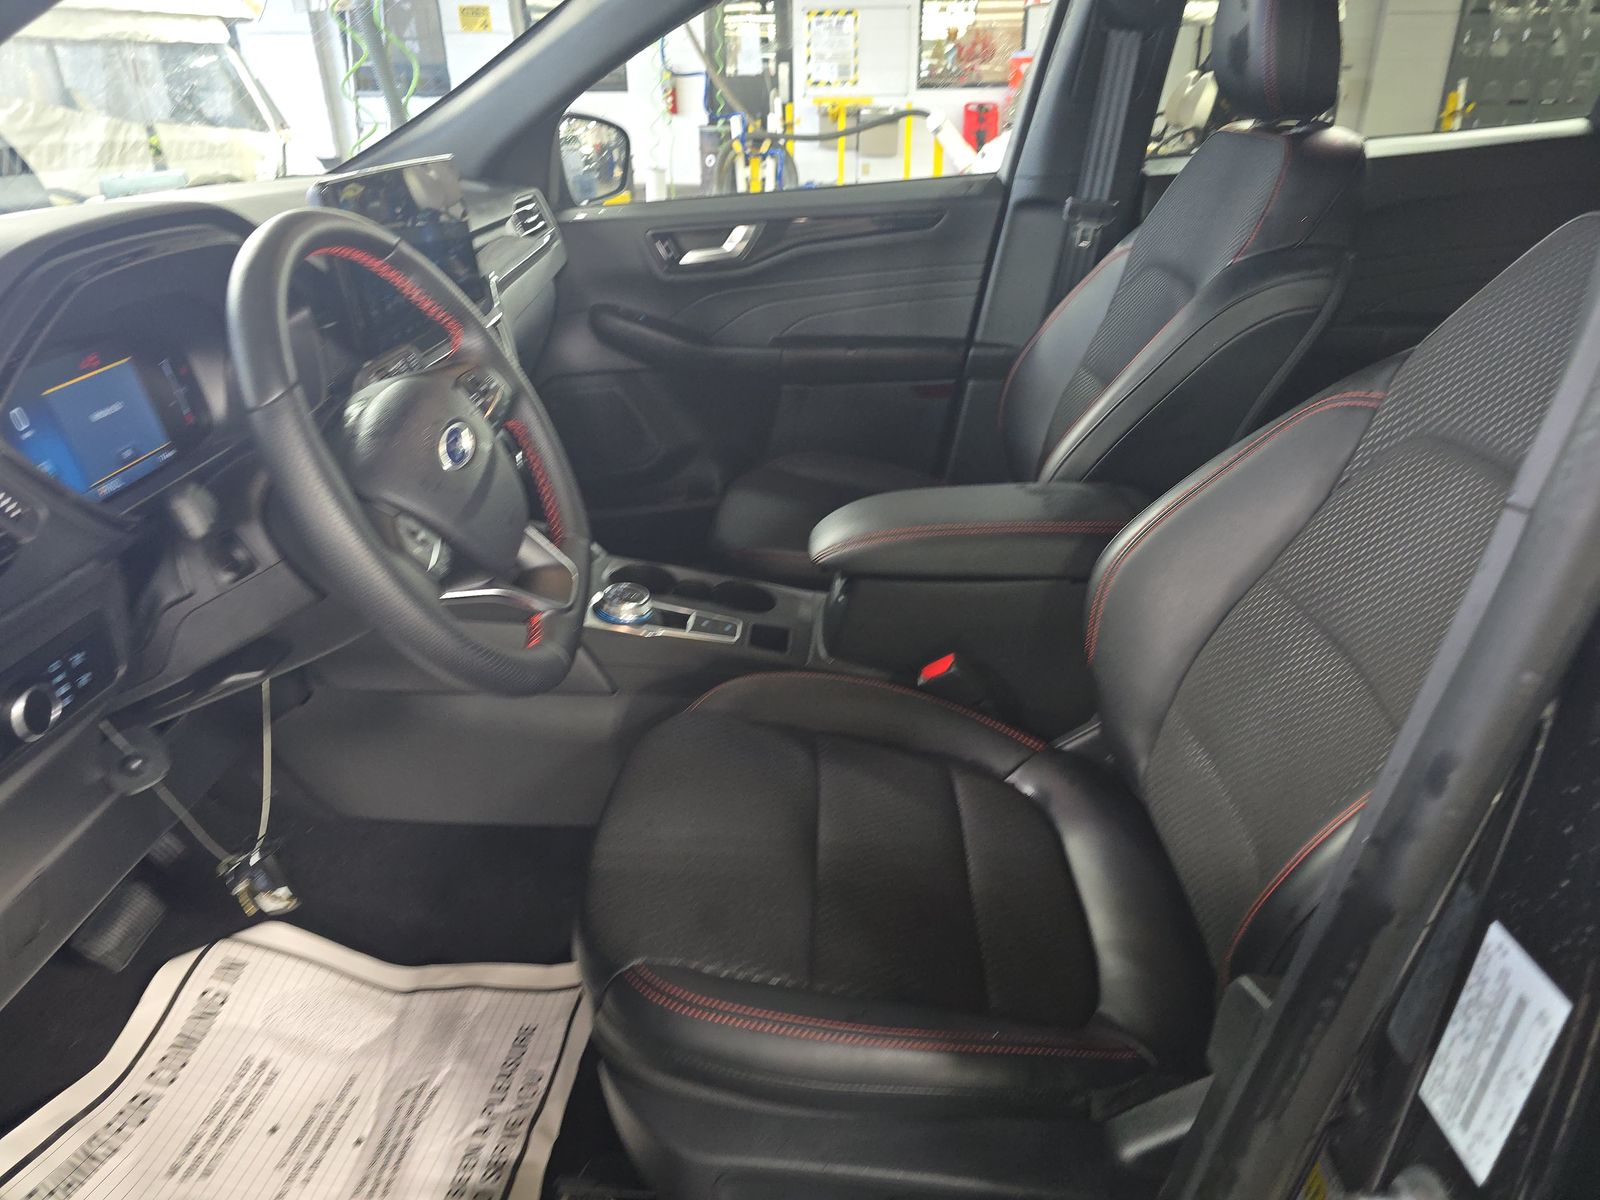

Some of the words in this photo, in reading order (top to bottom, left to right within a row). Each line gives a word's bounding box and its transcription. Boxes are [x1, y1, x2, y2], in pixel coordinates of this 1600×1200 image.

[103, 1091, 165, 1146] FOR
[145, 986, 232, 1087] COMING
[480, 1023, 540, 1119] PLEASURE
